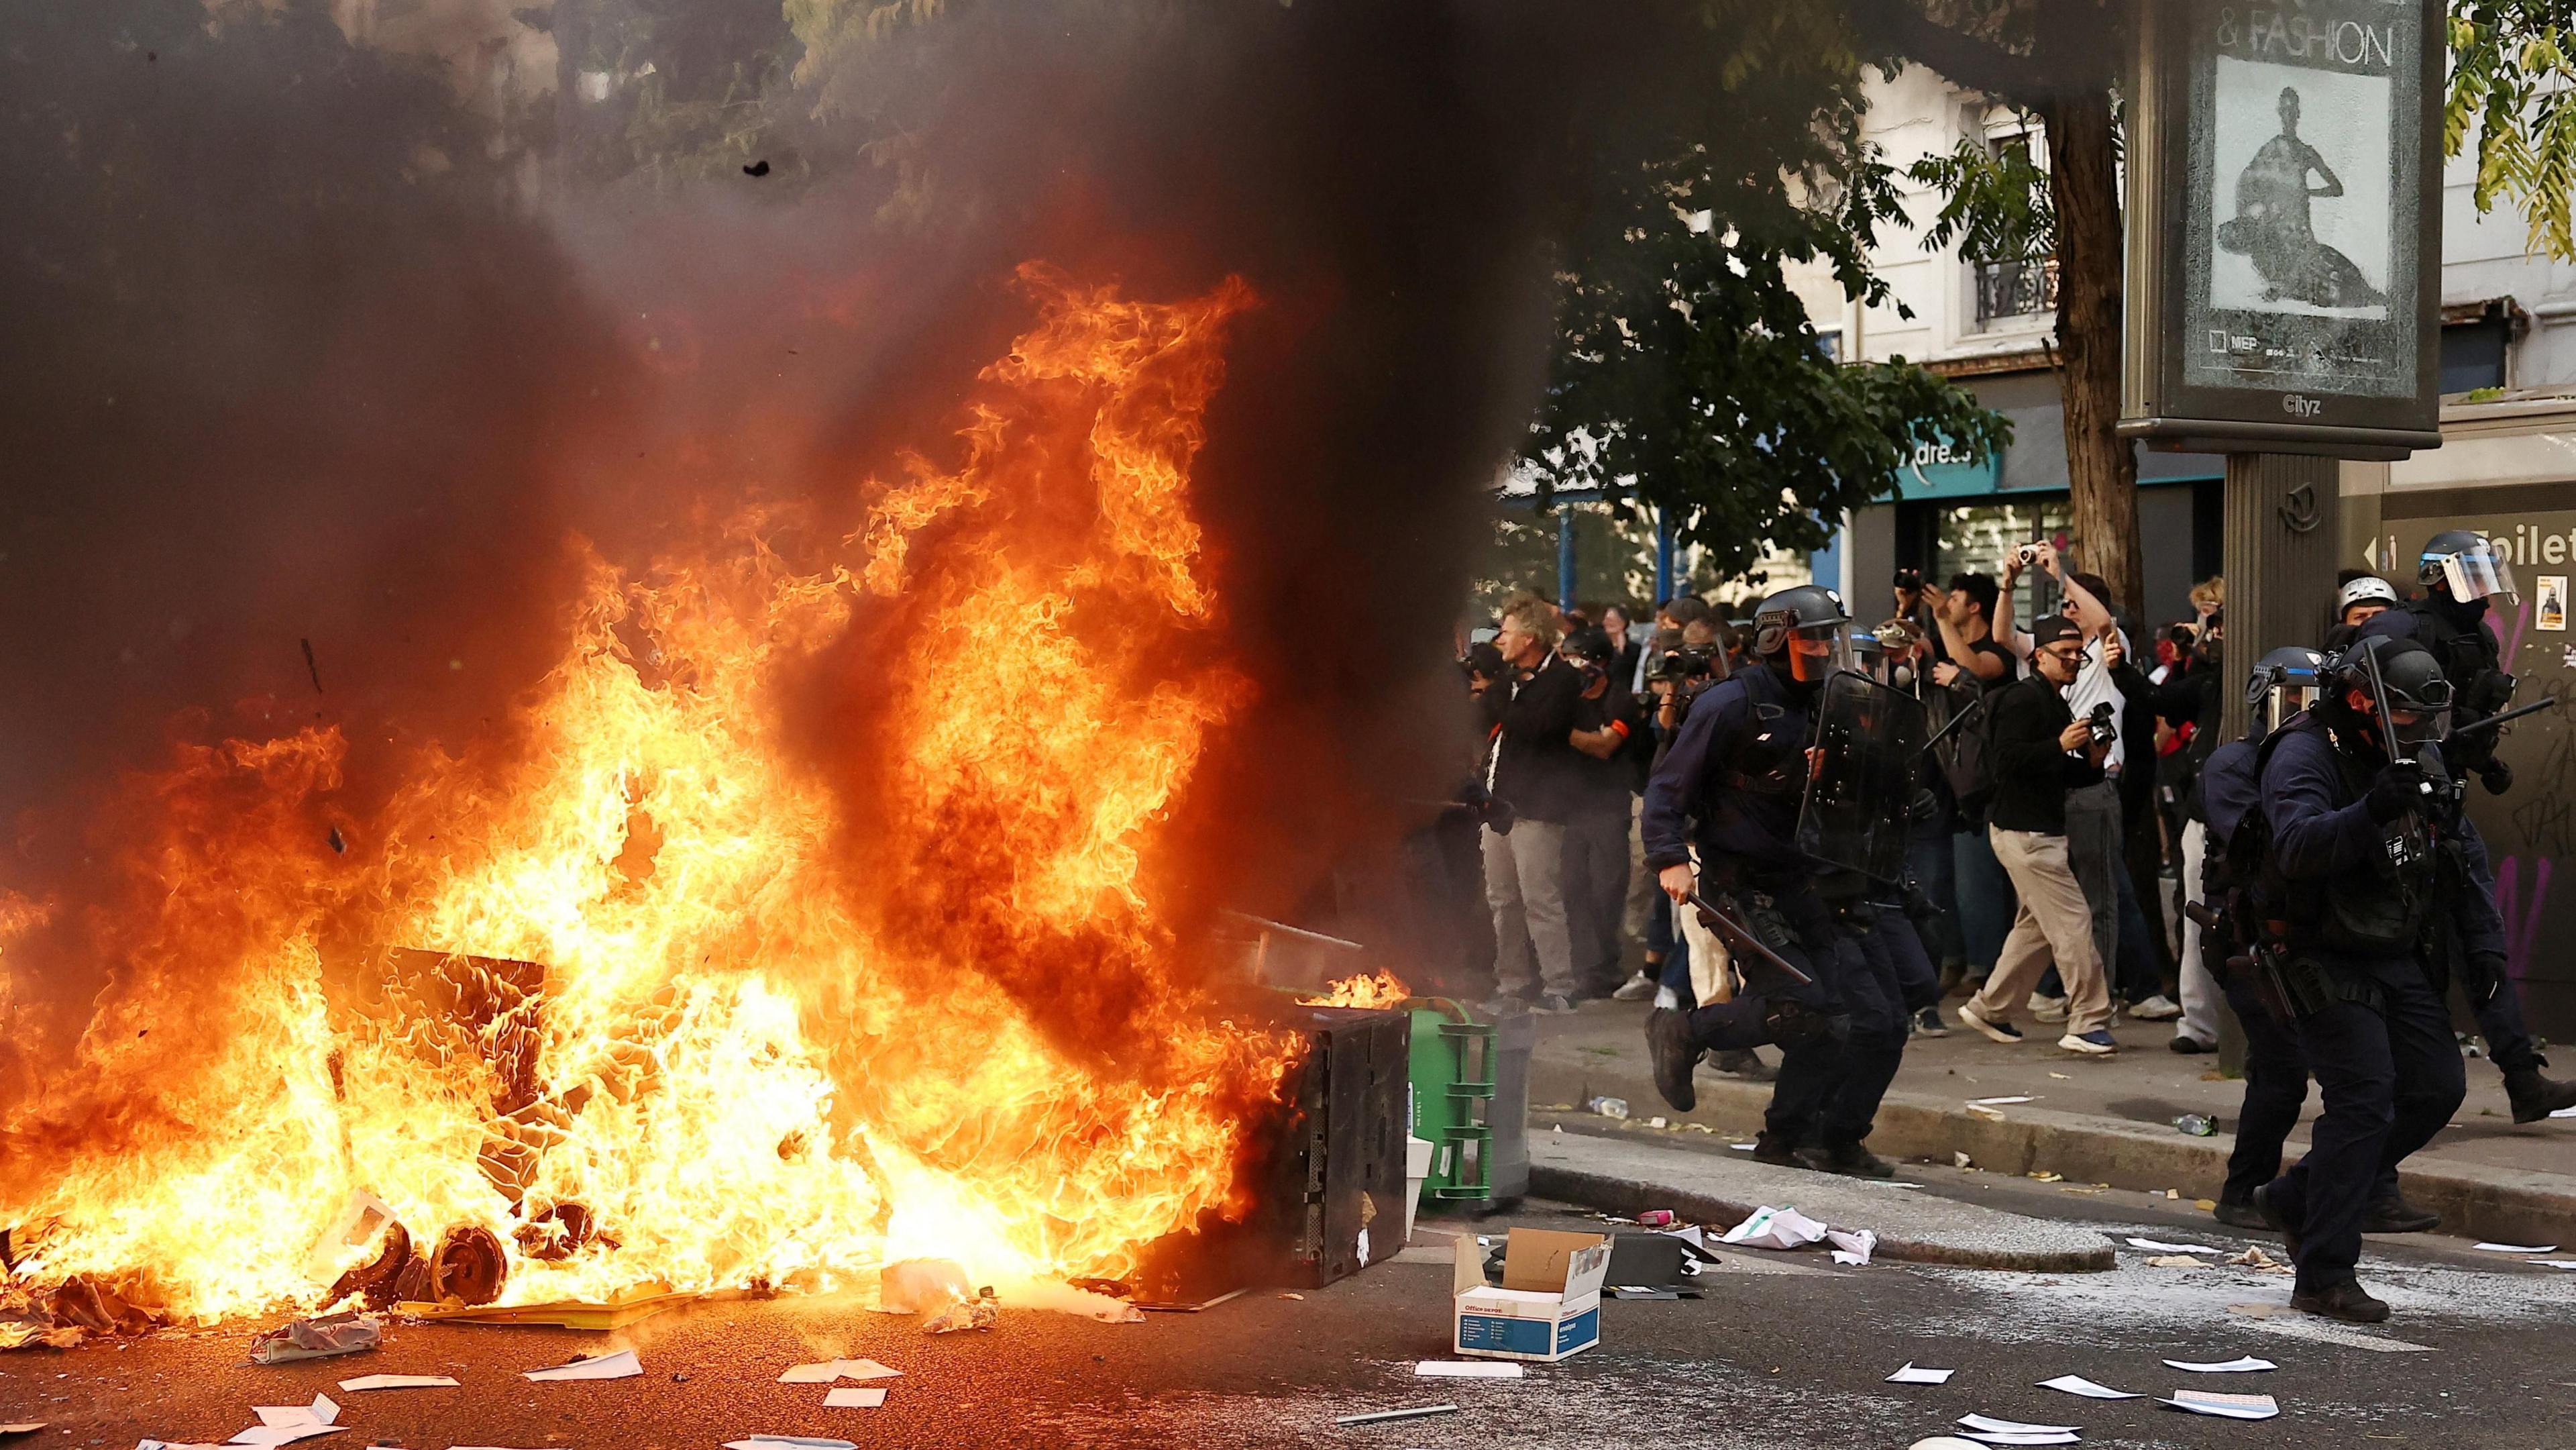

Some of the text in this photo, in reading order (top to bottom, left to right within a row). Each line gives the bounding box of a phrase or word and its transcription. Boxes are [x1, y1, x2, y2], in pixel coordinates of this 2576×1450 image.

[2217, 7, 2393, 67] & FASHION
[2284, 394, 2320, 417] Cityz
